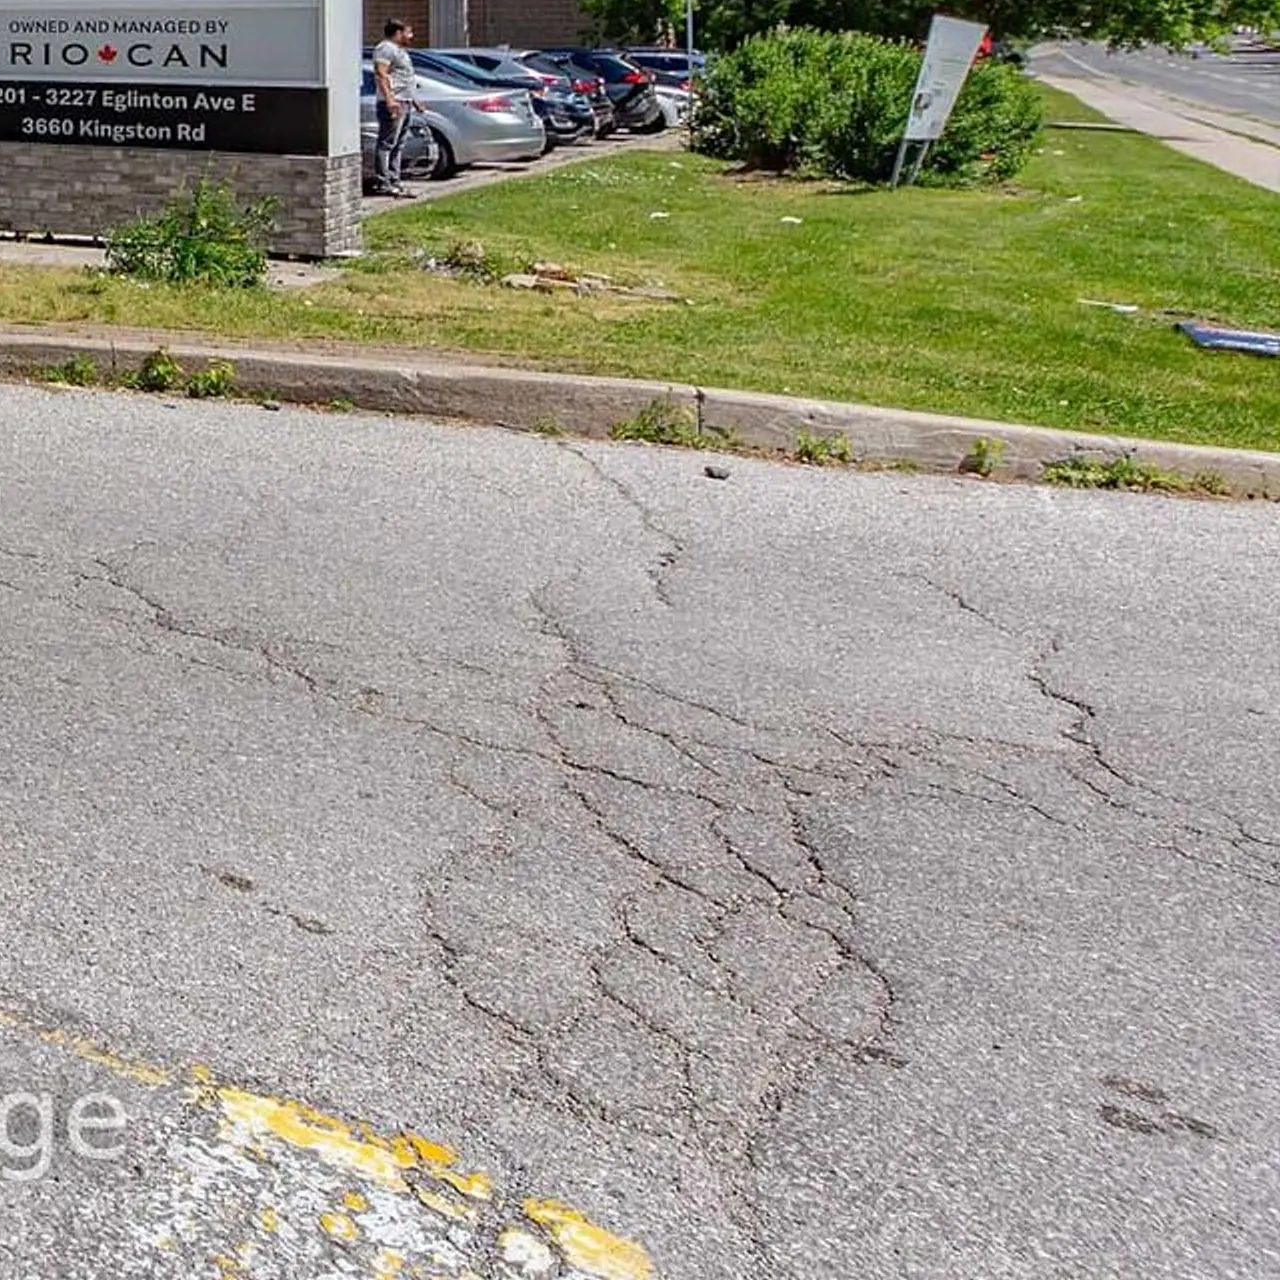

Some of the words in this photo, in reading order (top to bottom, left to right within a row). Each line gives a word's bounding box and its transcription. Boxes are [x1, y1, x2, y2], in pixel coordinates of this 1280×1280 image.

[8, 19, 69, 35] OWNED
[74, 20, 109, 35] AND
[113, 20, 201, 35] MANAGED
[205, 21, 229, 35] BY
[45, 89, 97, 107] 3227
[101, 90, 188, 112] Eglinton
[193, 93, 236, 111] Ave
[242, 94, 256, 112] E
[21, 118, 74, 136] 3660
[79, 120, 172, 142] Kingston
[177, 124, 206, 142] Rd
